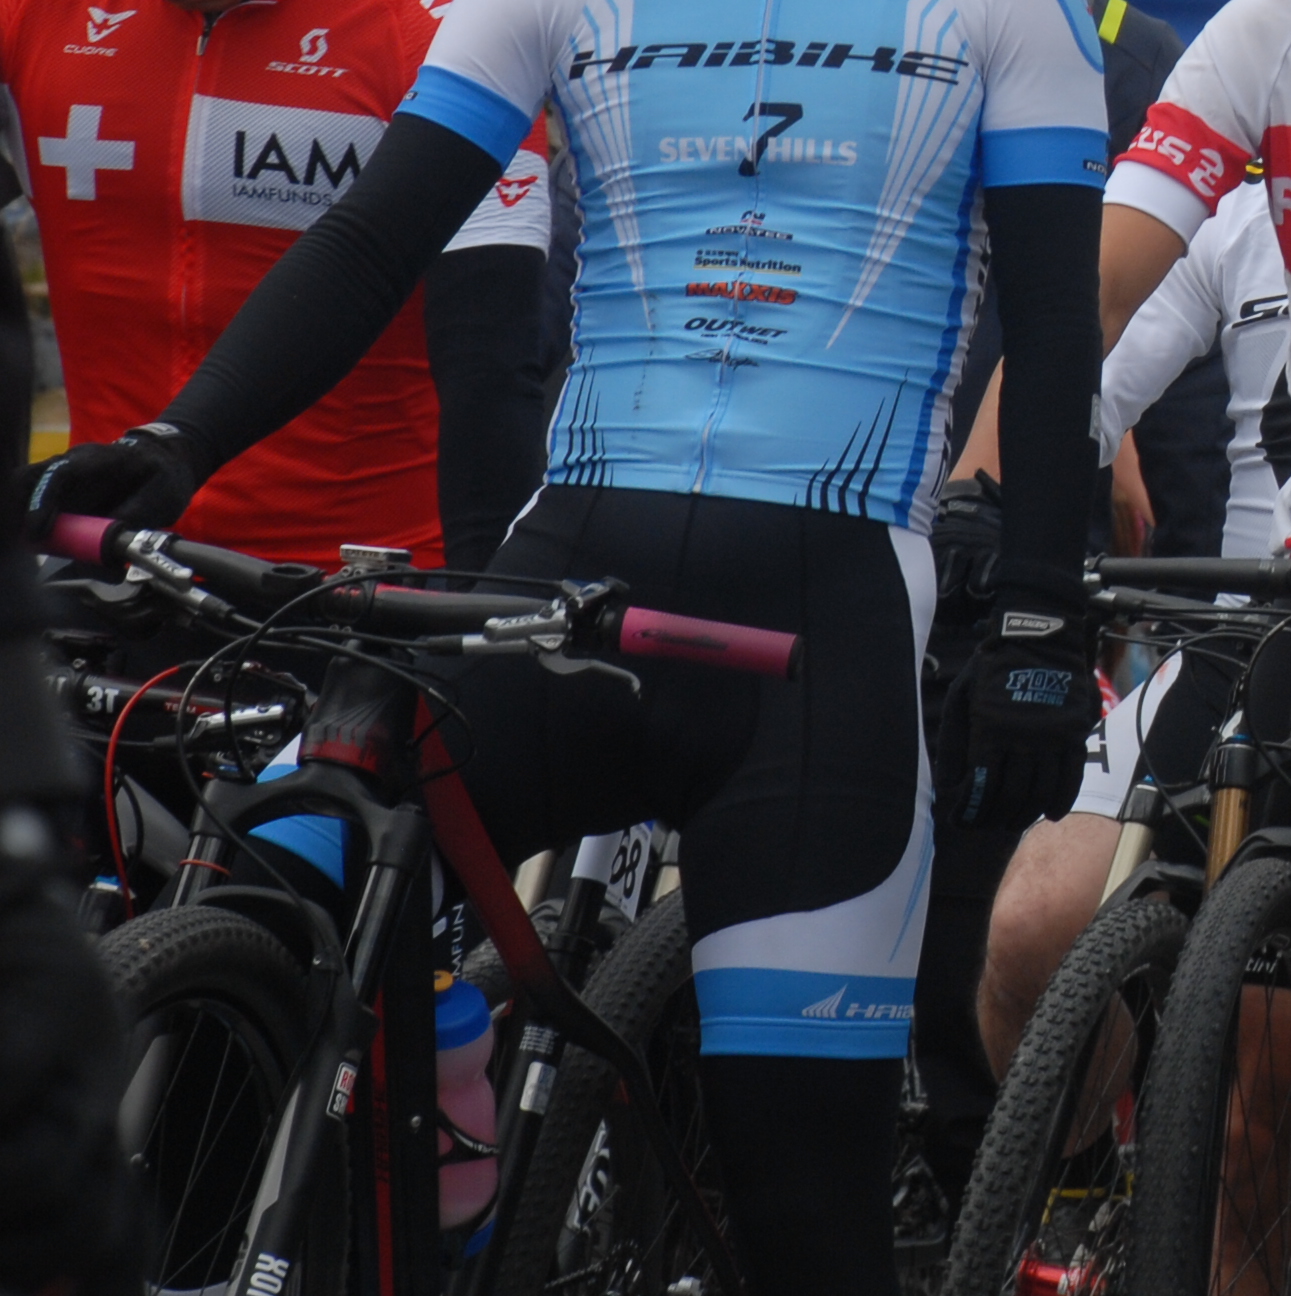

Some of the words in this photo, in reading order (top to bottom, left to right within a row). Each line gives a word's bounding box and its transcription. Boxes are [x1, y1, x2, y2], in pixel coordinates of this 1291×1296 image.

[265, 60, 349, 79] SCOTT
[568, 37, 970, 87] HAIBIKE
[659, 135, 753, 163] SEVEN
[768, 136, 859, 167] HILLS
[738, 101, 804, 177] 7
[232, 184, 335, 207] IAMFUNDS
[695, 256, 738, 267] Sports
[686, 280, 798, 305] MAXXIS
[1006, 668, 1072, 694] FOX
[87, 685, 121, 714] 3T
[1011, 690, 1065, 708] RACING
